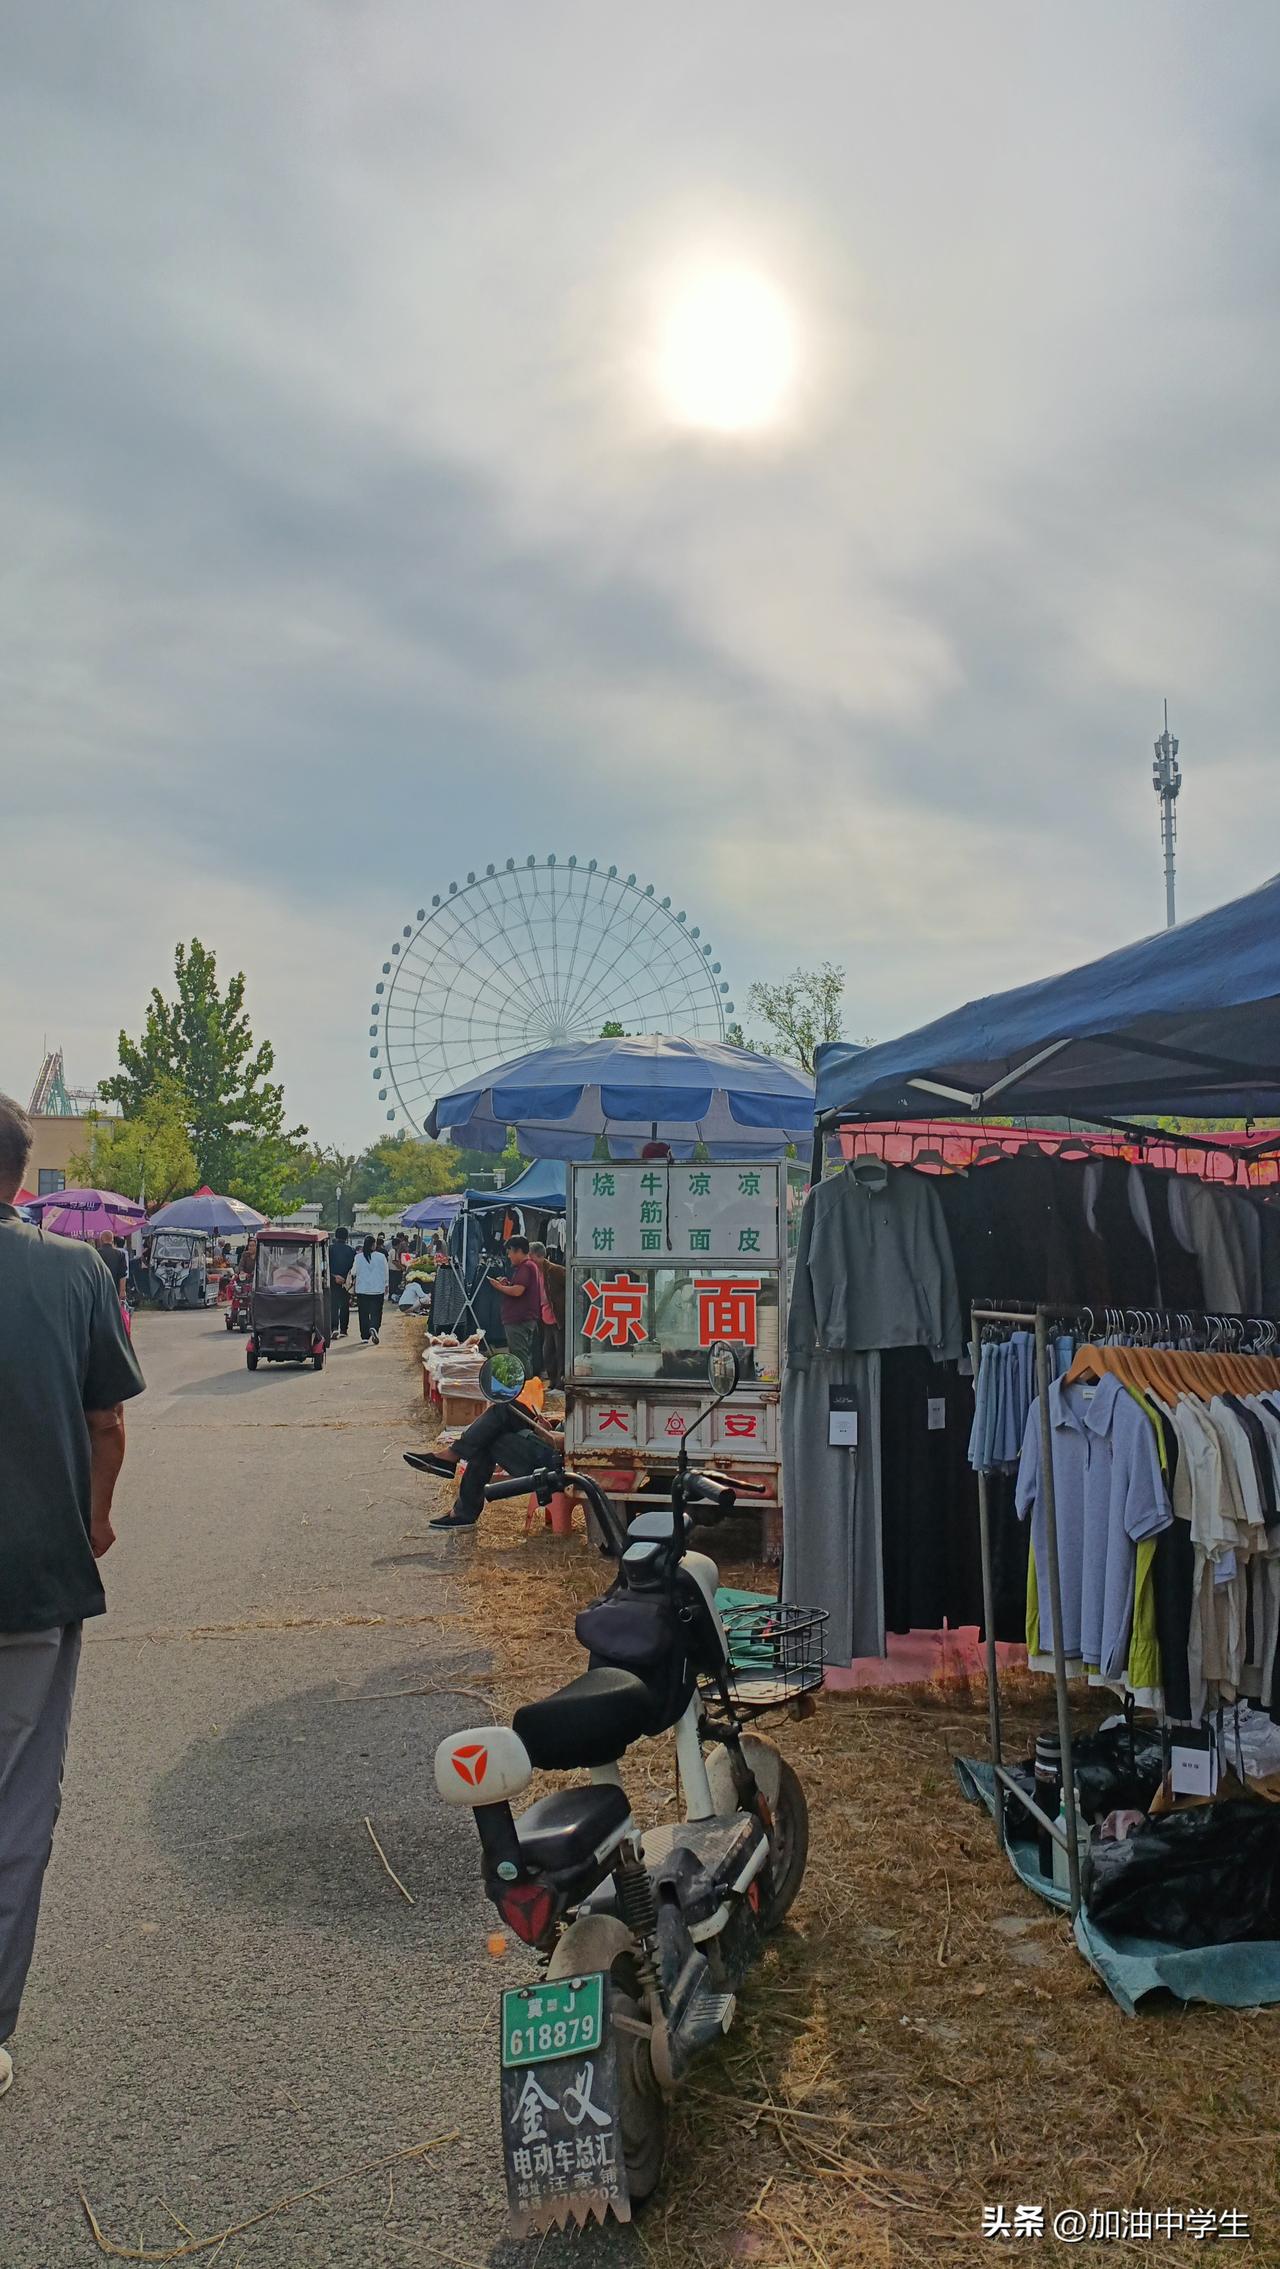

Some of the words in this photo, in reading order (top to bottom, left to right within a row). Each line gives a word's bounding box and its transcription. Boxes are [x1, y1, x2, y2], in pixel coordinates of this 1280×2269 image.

[592, 1172, 615, 1251] 烧饼
[640, 1172, 662, 1251] 牛筋面
[688, 1172, 711, 1251] 凉面
[738, 1172, 761, 1251] 凉皮
[580, 1273, 762, 1347] 凉面
[510, 2015, 594, 2056] 618879
[512, 2132, 616, 2180] 电动车总汇
